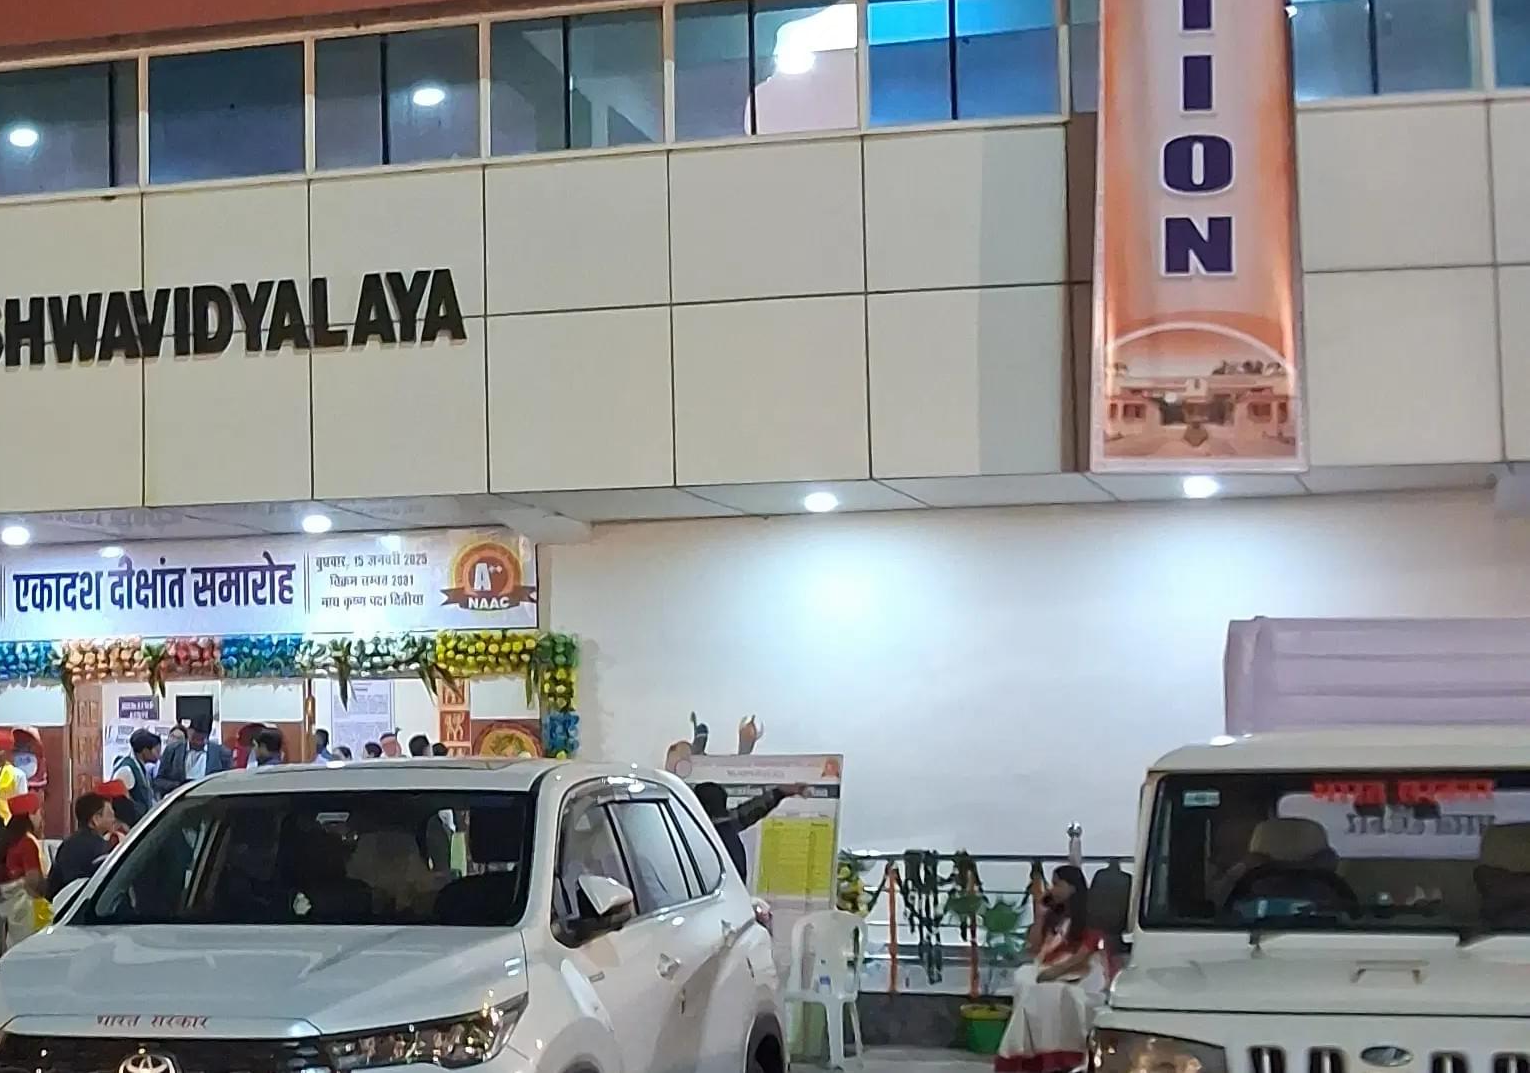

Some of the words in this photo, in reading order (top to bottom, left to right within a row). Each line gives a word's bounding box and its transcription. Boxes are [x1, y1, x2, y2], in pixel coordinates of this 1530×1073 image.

[13, 571, 103, 612] एकादश
[109, 556, 186, 609] दीक्षांत
[191, 551, 295, 607] समारोह
[468, 597, 511, 608] NAAC
